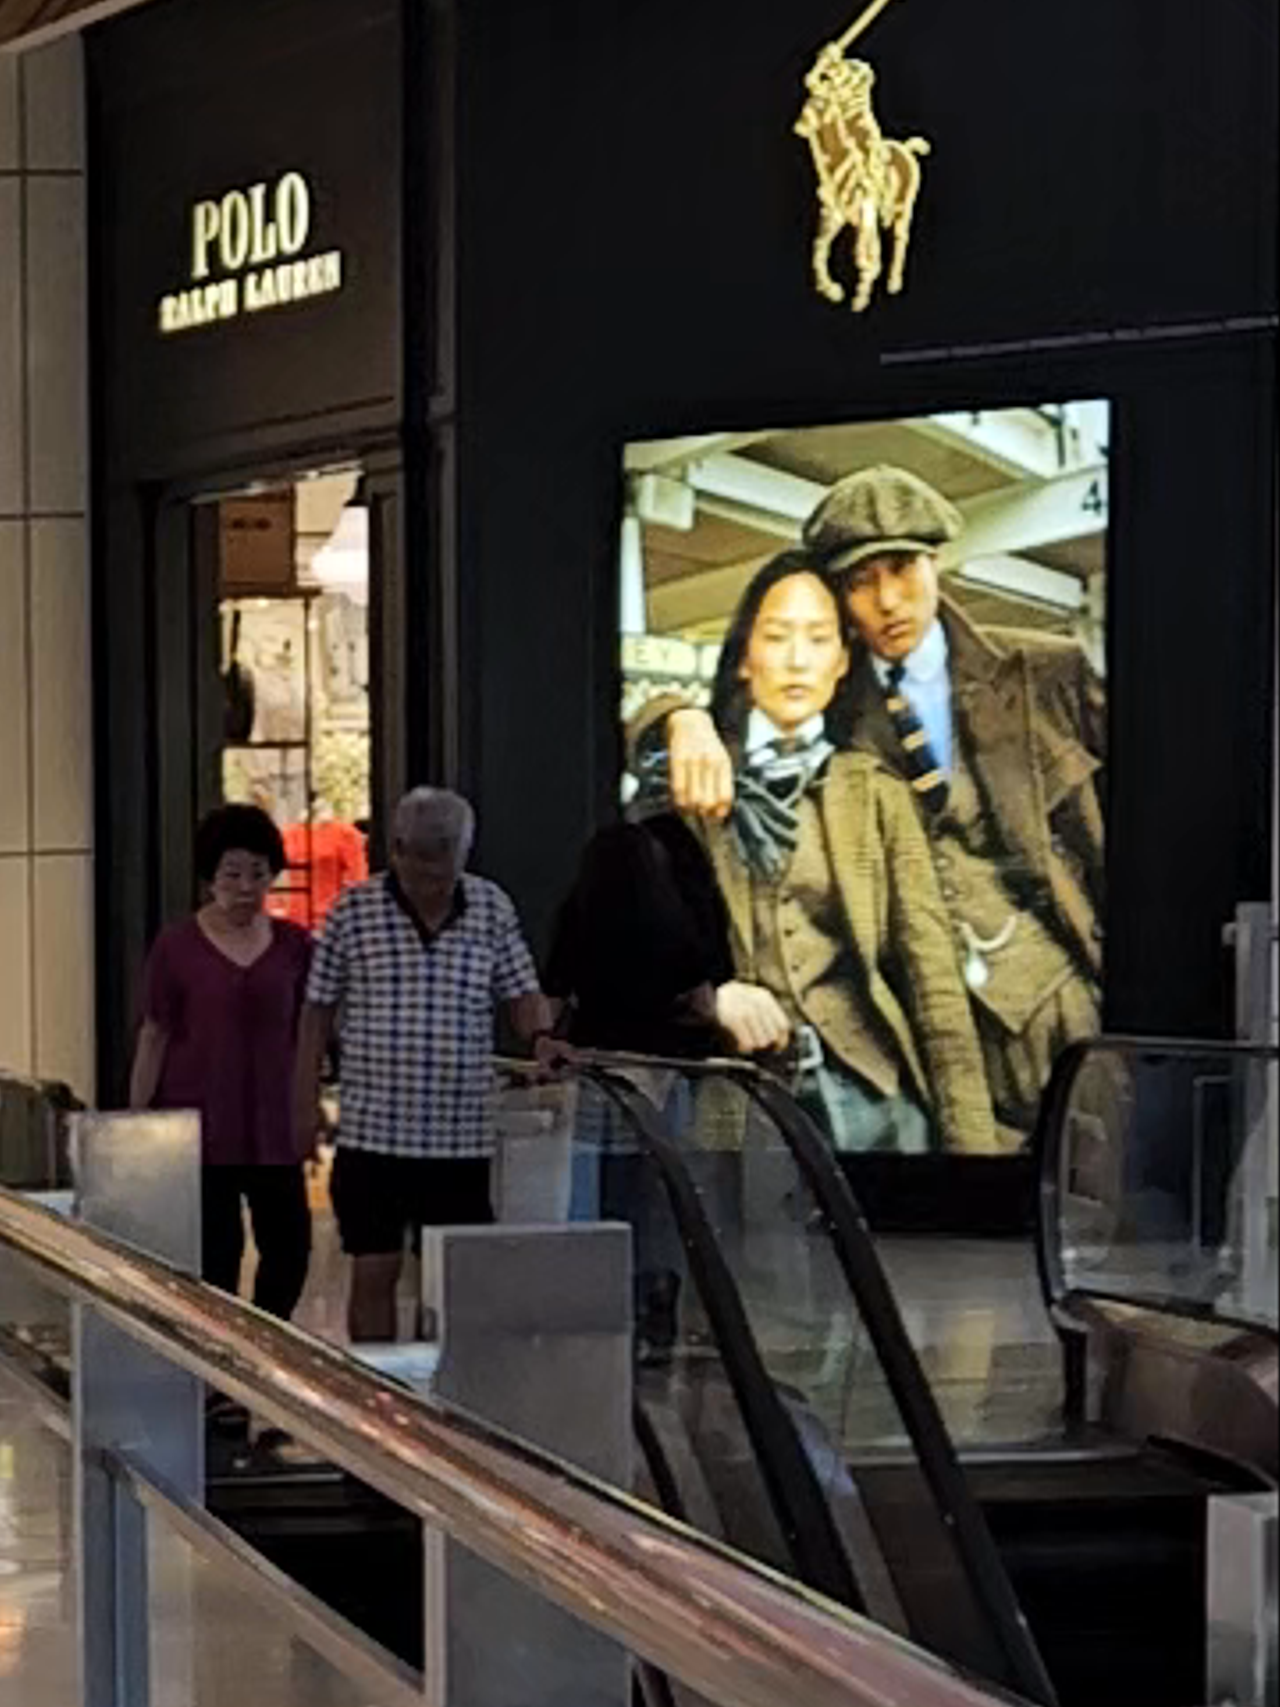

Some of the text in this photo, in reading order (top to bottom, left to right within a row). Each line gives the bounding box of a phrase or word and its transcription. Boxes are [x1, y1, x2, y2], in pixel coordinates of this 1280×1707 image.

[193, 171, 310, 279] POLO
[160, 249, 341, 331] RALPH LAUREN
